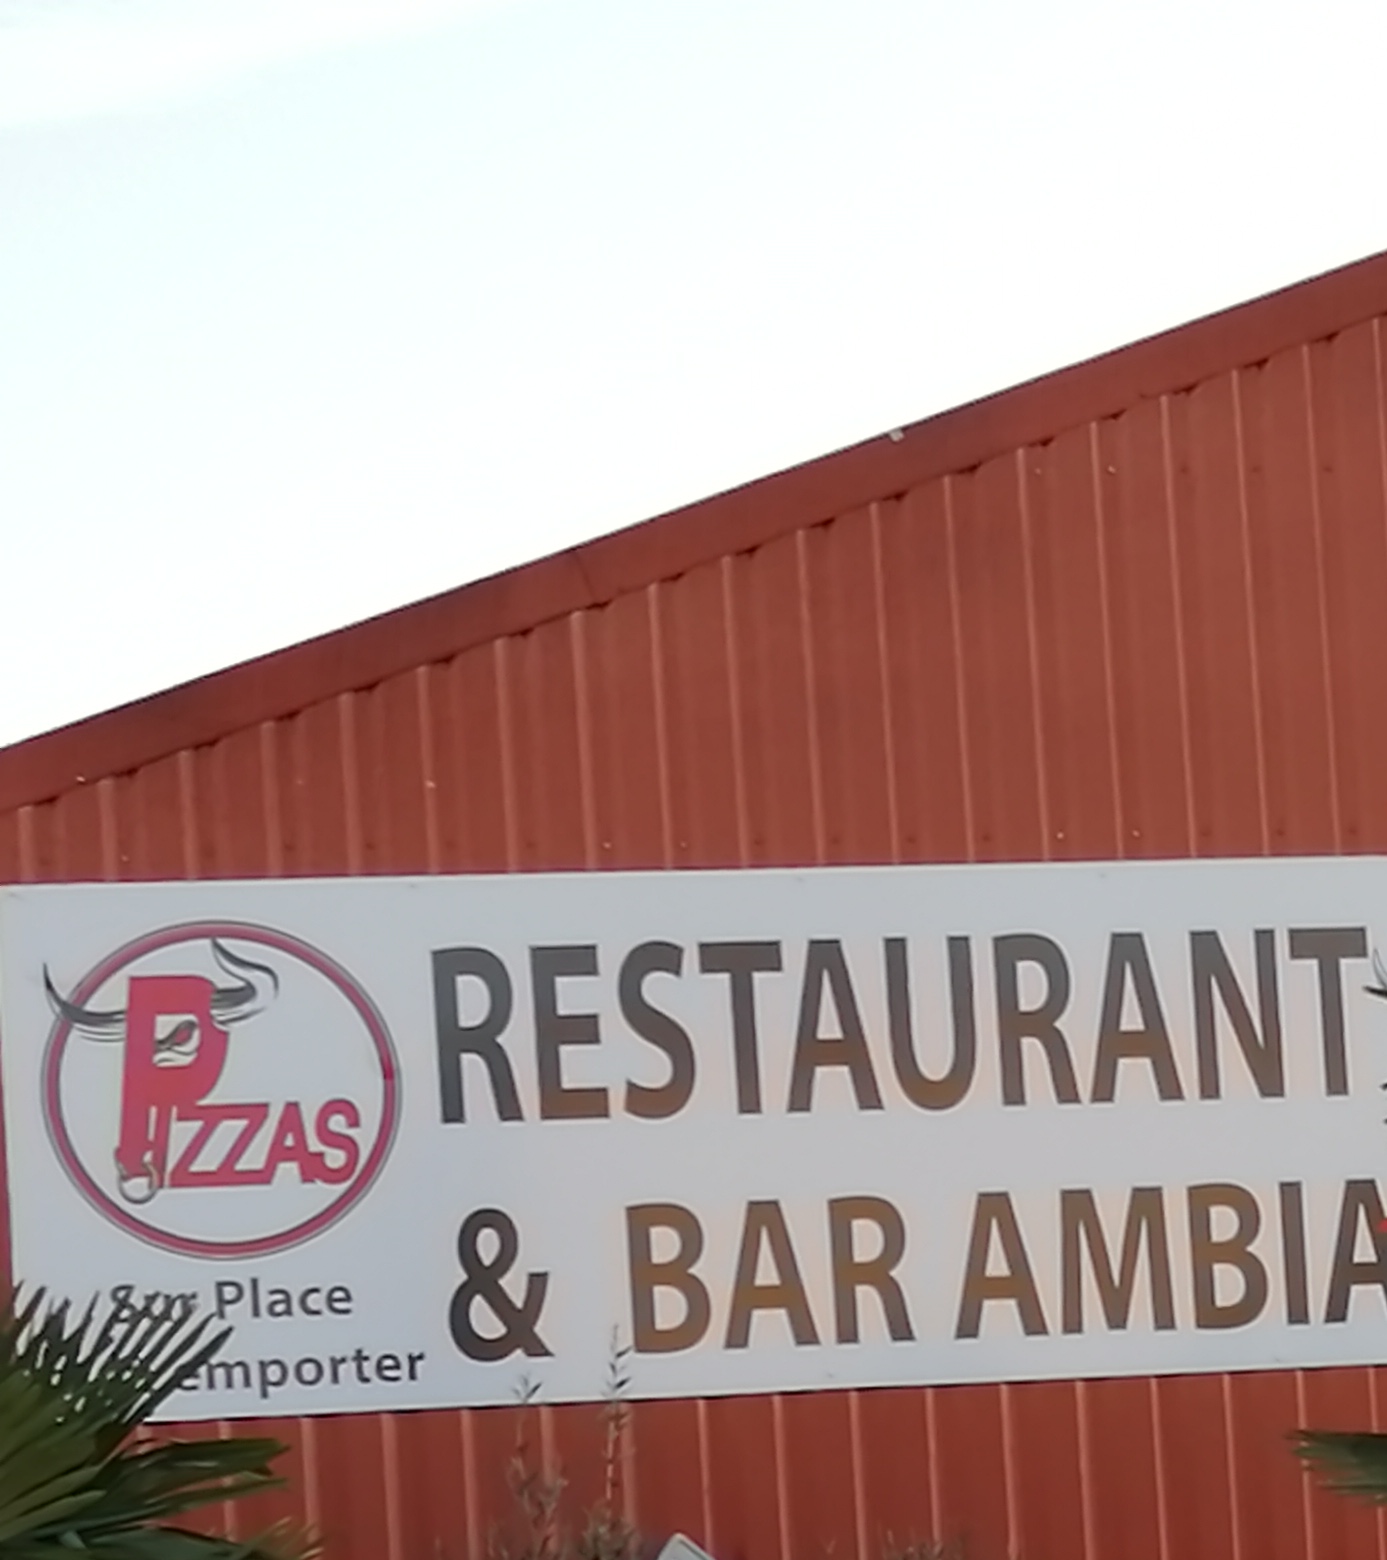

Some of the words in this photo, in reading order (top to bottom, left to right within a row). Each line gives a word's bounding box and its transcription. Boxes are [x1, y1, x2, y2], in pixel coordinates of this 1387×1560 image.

[430, 926, 1368, 1125] RESTAURANT
[214, 1277, 353, 1320] Place
[448, 1208, 554, 1363] &
[625, 1195, 916, 1355] BAR
